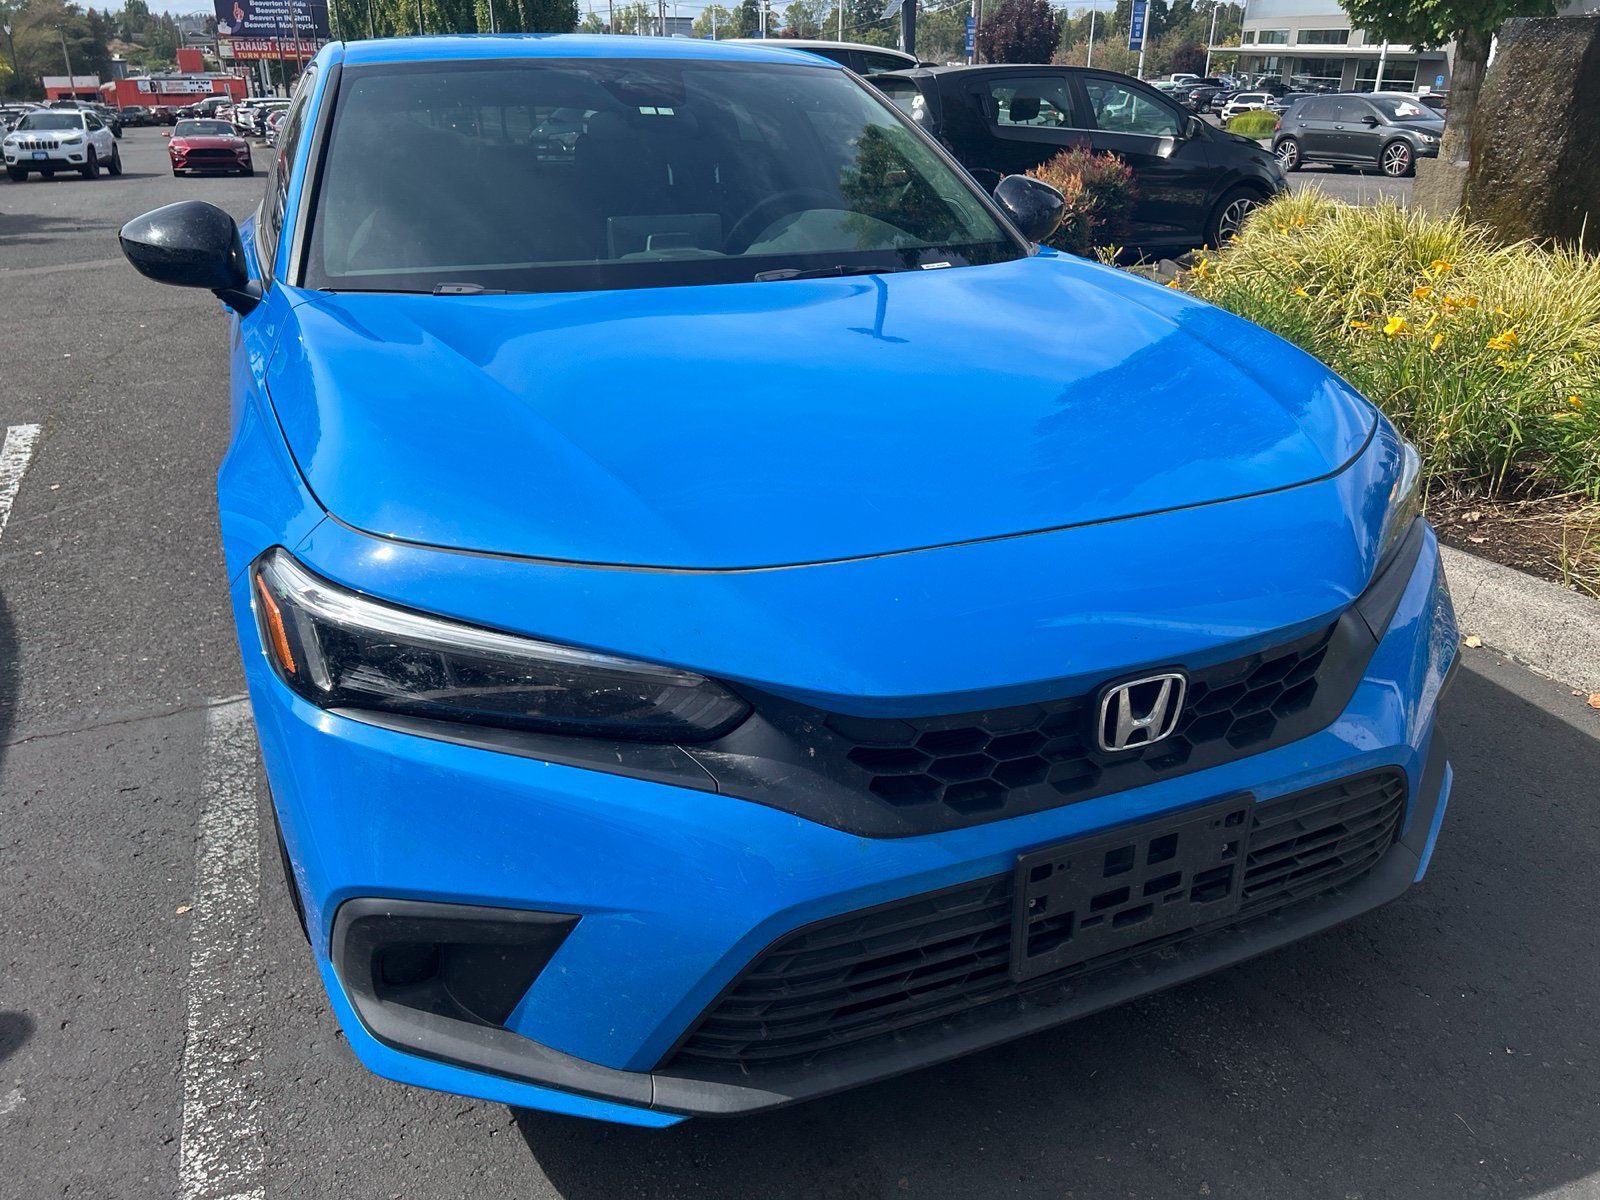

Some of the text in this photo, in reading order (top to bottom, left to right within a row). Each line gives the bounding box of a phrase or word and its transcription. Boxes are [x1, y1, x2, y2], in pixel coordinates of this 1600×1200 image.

[279, 22, 318, 30] Motrcycles
[234, 41, 322, 52] EXHAUST SPECALTIES
